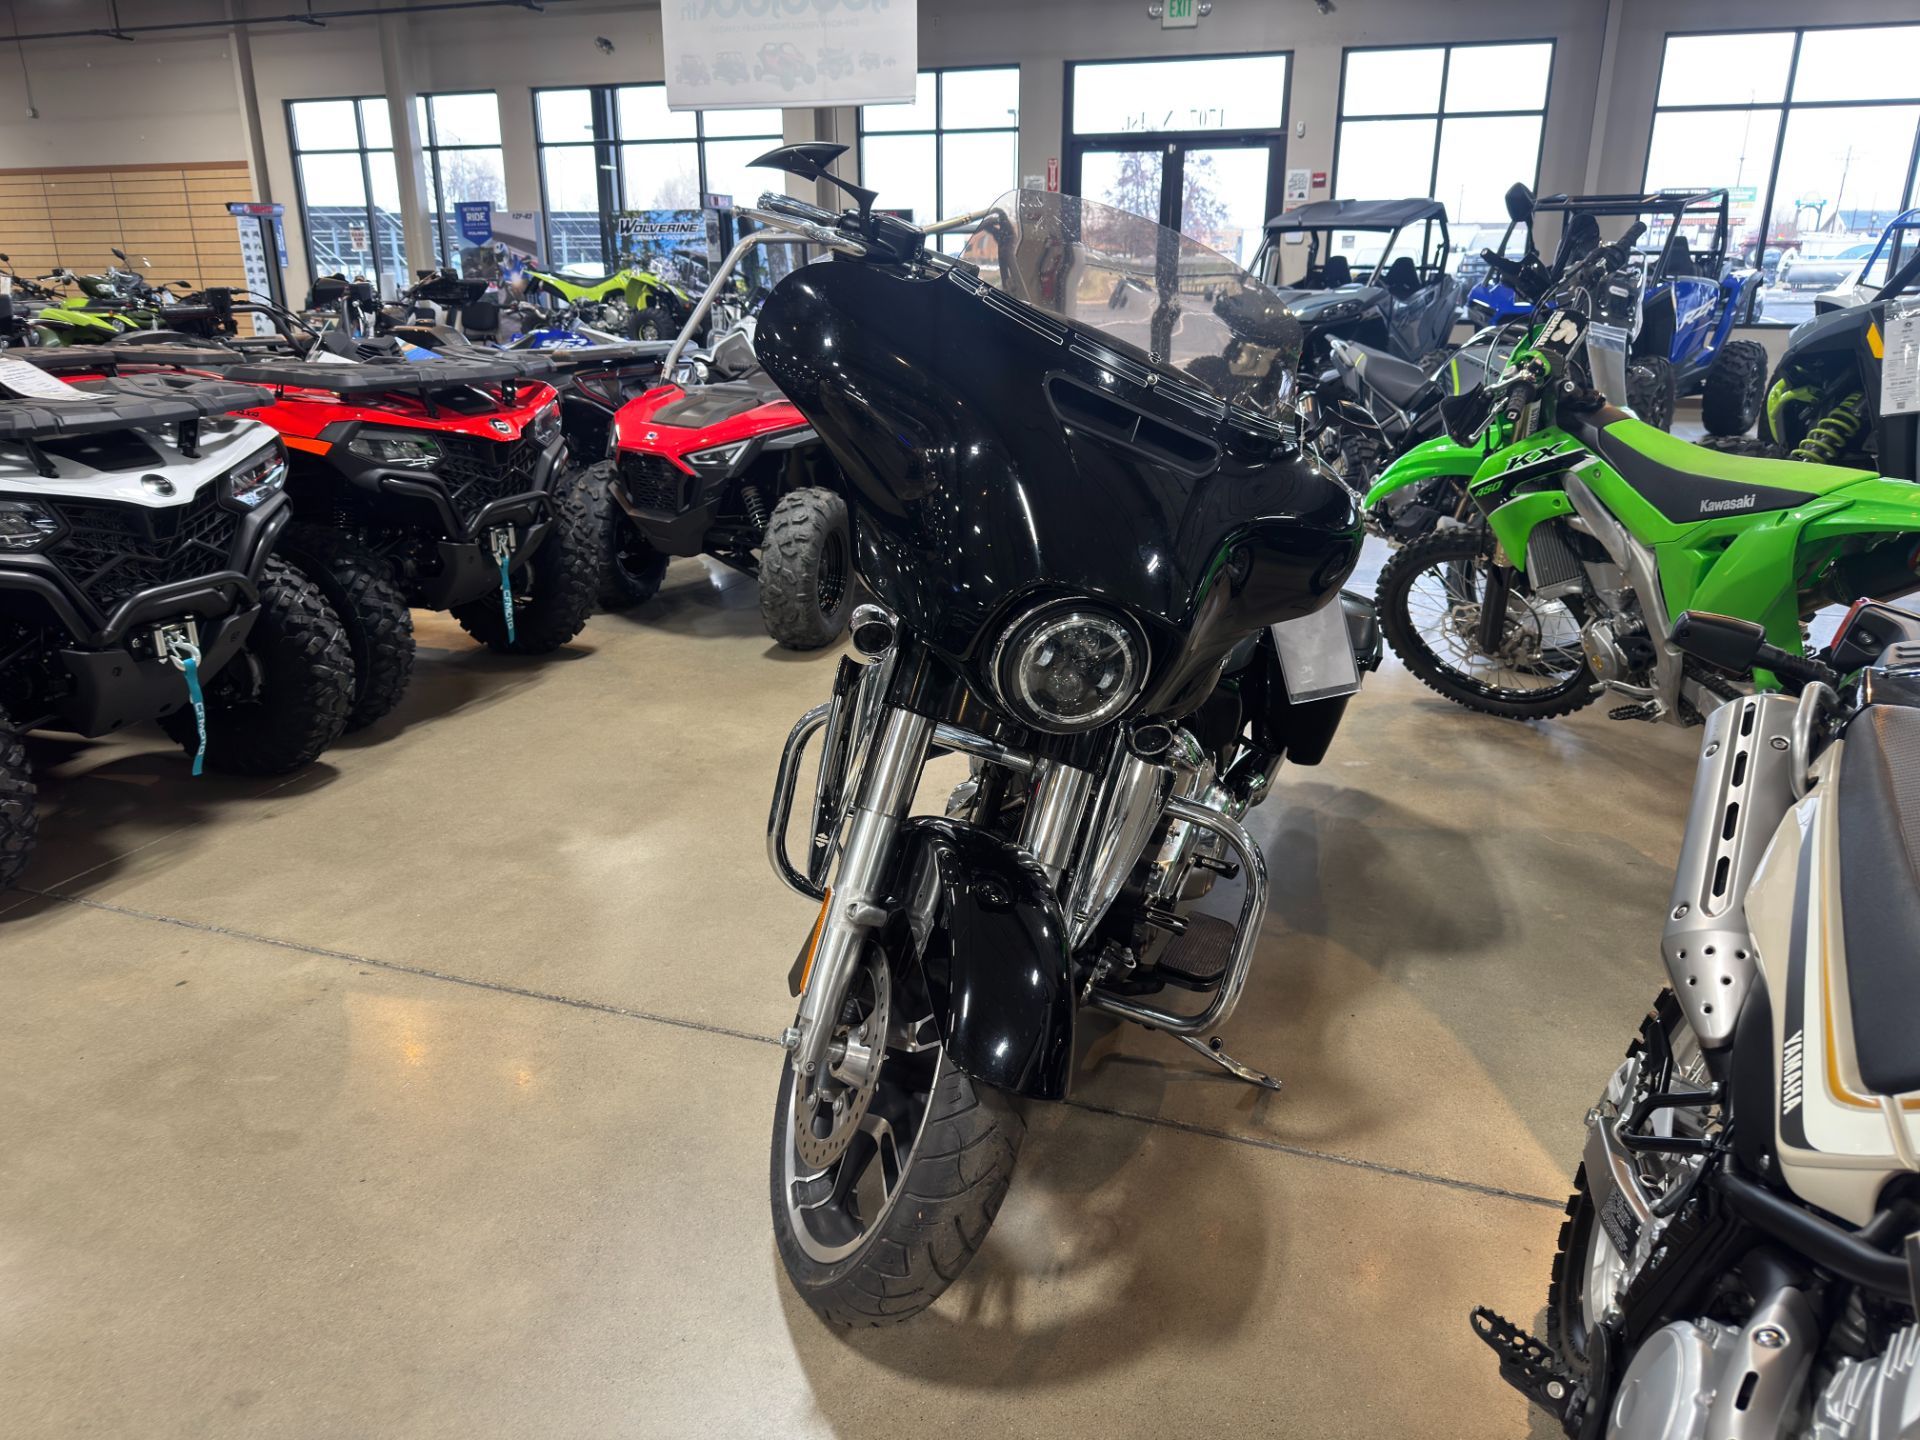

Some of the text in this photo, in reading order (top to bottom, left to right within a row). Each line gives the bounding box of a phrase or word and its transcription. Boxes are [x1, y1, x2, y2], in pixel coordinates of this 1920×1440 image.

[1169, 0, 1193, 17] EXIT
[466, 212, 487, 222] RIDE
[618, 218, 699, 236] WOLVERINE
[1678, 296, 1718, 331] RZR
[1505, 440, 1570, 473] KX
[1474, 480, 1503, 497] 450
[1699, 493, 1757, 513] Kawasaki
[502, 589, 514, 630] CFMOTO
[194, 702, 207, 756] CFMOTO
[1782, 1029, 1803, 1116] YAMAHA
